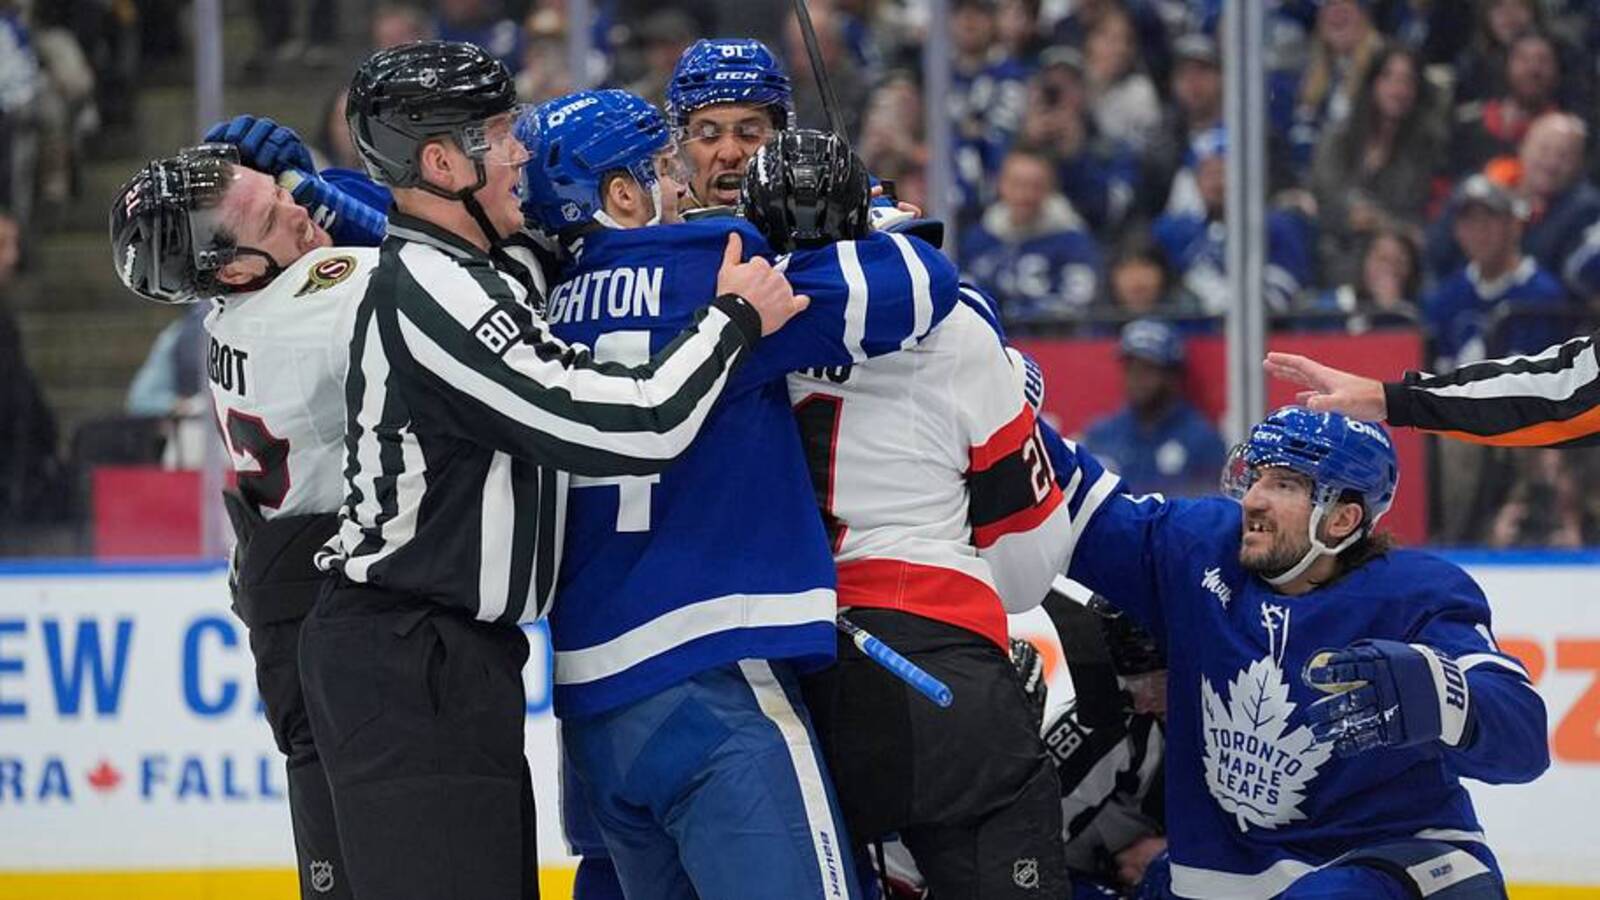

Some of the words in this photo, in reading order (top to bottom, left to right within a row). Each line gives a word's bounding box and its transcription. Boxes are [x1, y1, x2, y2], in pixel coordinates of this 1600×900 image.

[546, 267, 664, 325] GHTON
[475, 310, 520, 354] 80
[206, 336, 248, 396] BOT
[0, 620, 135, 716] EW
[1209, 727, 1303, 777] TORONTO
[1218, 748, 1283, 788] MAPLE
[0, 756, 72, 800] RA
[141, 756, 284, 800] FALL
[1217, 767, 1281, 806] LEAFS
